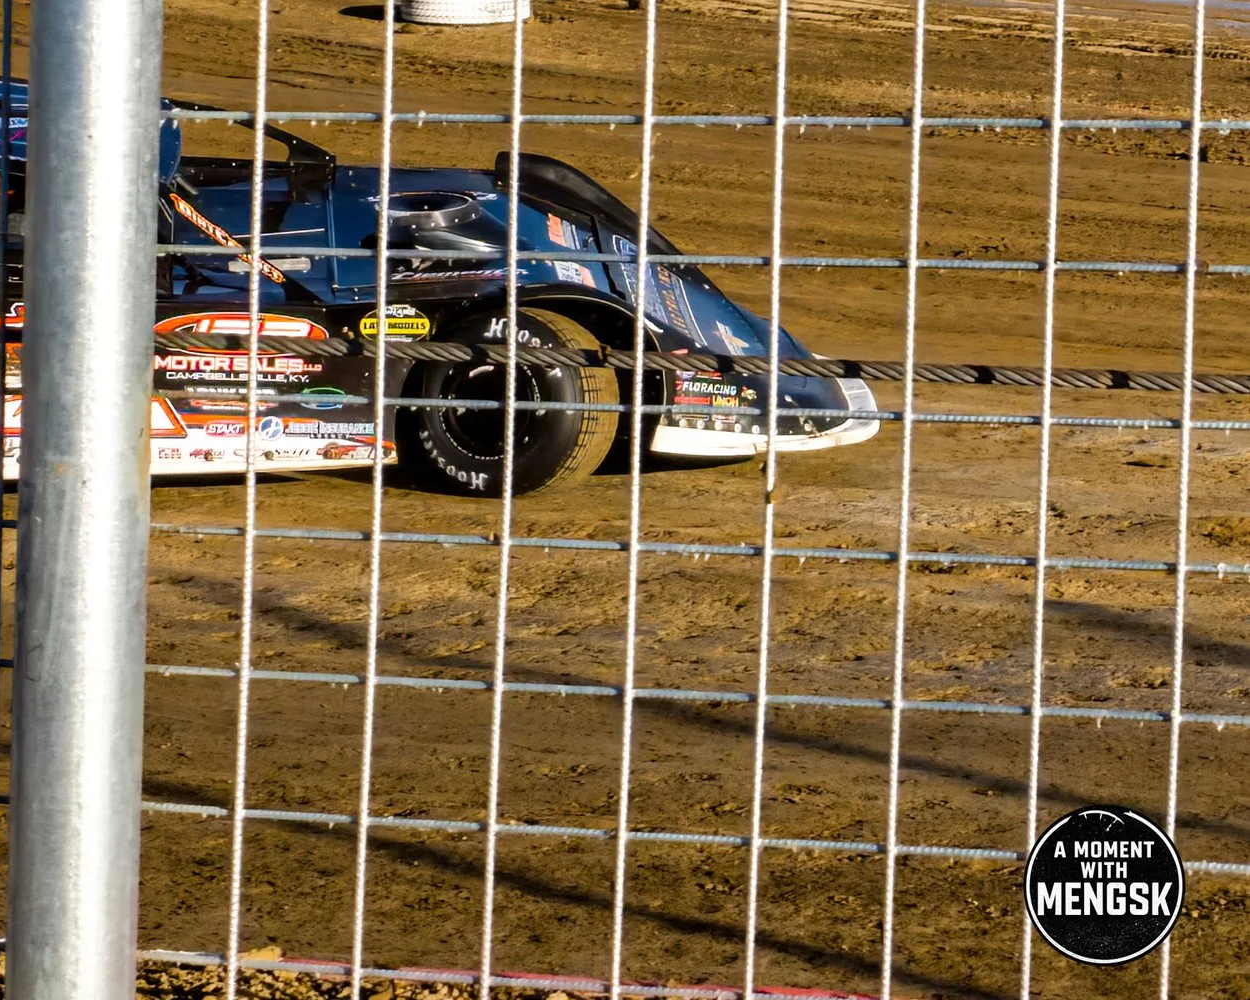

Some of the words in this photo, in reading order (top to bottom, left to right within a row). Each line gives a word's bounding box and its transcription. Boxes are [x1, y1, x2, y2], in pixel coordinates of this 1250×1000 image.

[387, 322, 426, 330] MODELS
[154, 354, 231, 371] MOTOR
[166, 371, 287, 383] CAMPBELLSILLE,
[288, 374, 310, 383] KY.
[682, 381, 738, 396] FLORACING
